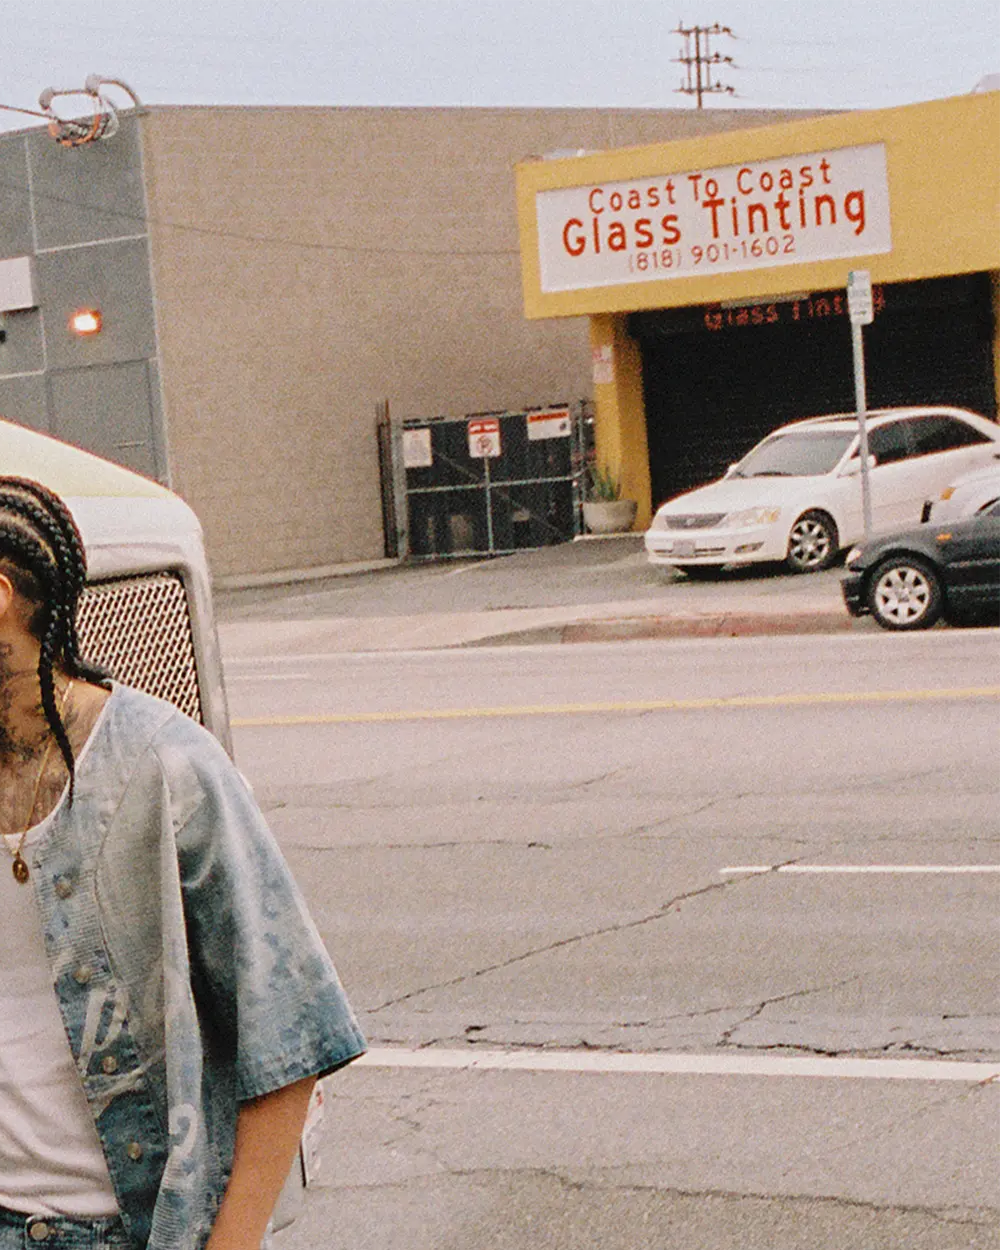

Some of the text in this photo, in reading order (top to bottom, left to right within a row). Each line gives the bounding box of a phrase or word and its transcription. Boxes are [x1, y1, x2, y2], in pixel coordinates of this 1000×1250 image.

[589, 158, 832, 215] Coast To Coast
[562, 189, 866, 257] Glass Tinting
[628, 234, 796, 273] (818) 901-1602
